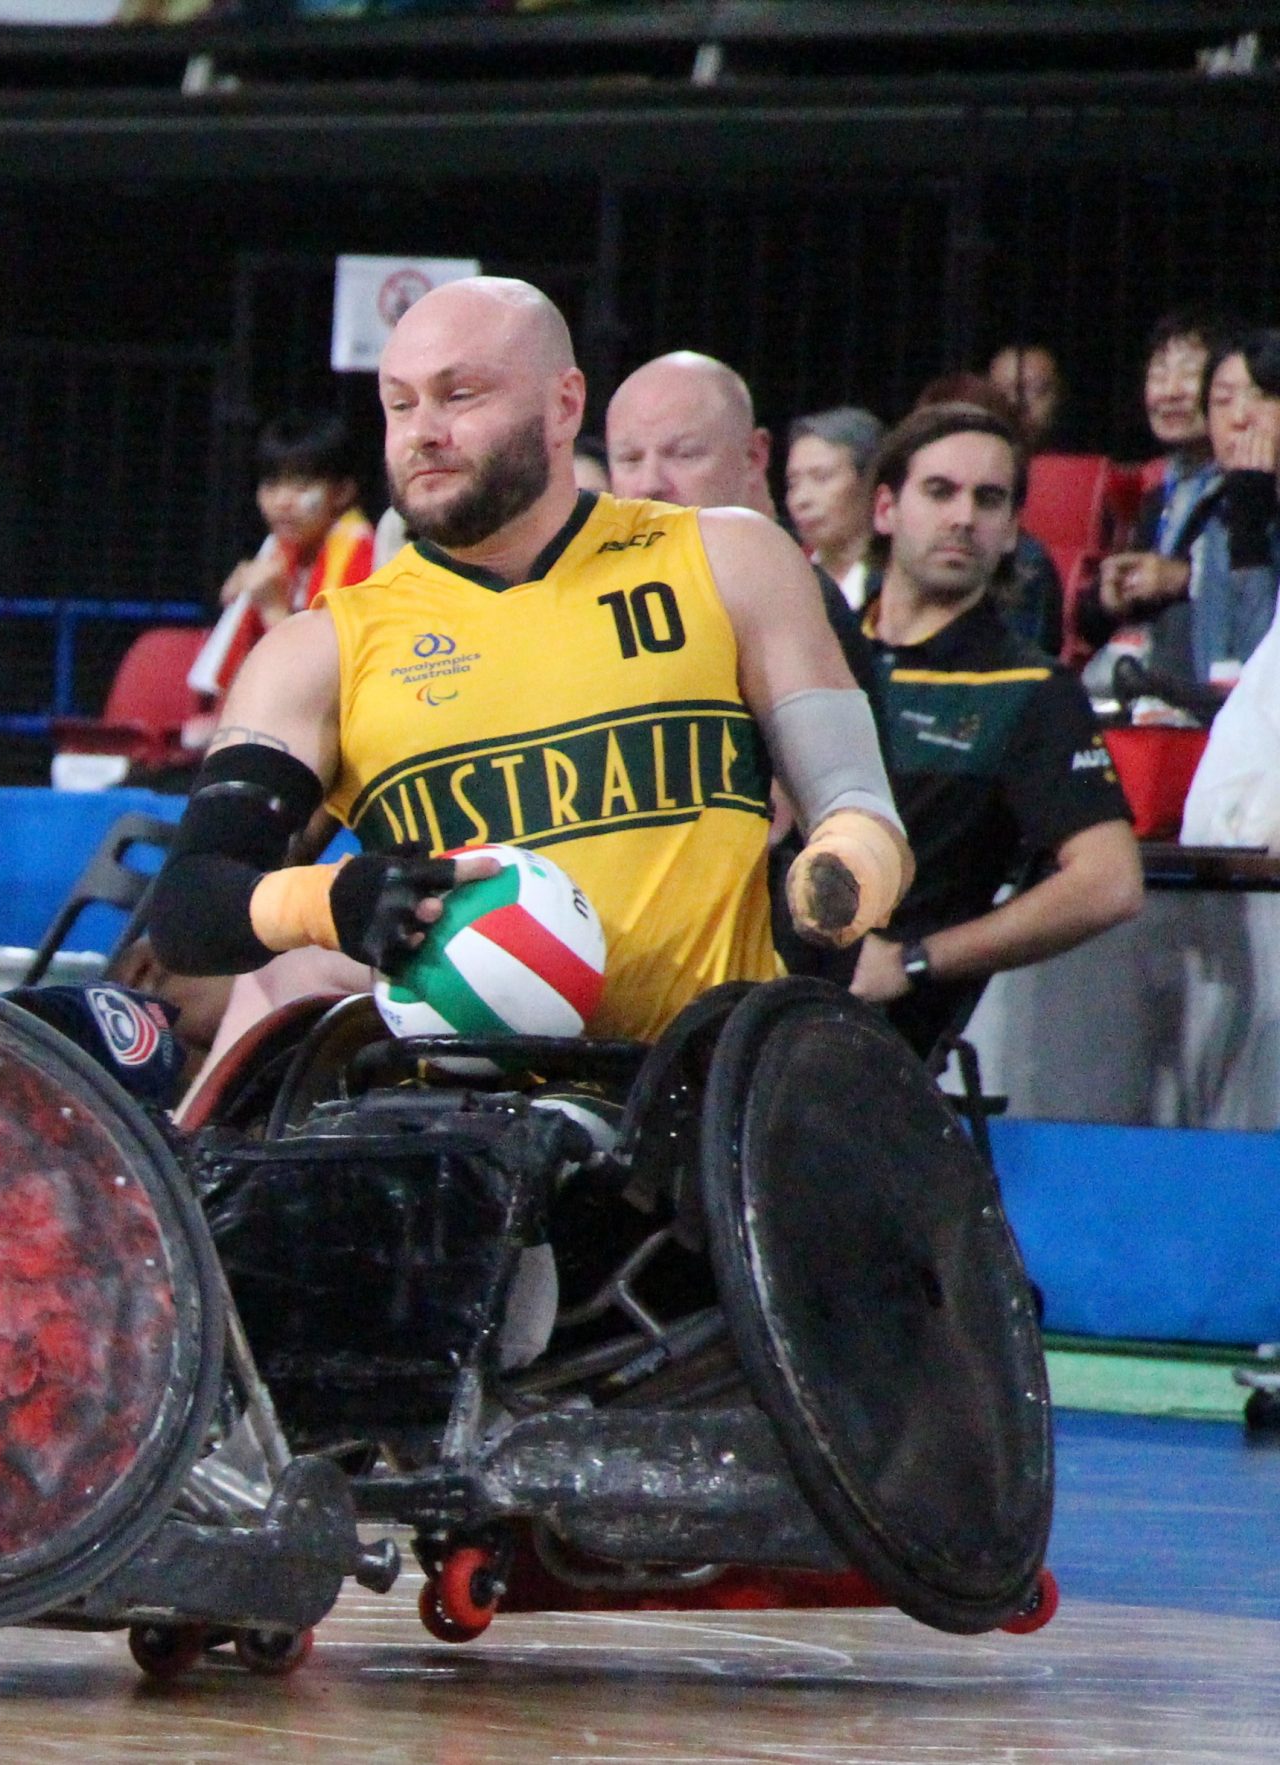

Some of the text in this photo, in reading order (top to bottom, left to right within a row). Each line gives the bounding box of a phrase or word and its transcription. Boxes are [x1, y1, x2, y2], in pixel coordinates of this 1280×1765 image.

[597, 581, 686, 659] 10
[390, 652, 482, 676] Paralympics
[402, 664, 471, 685] Australia
